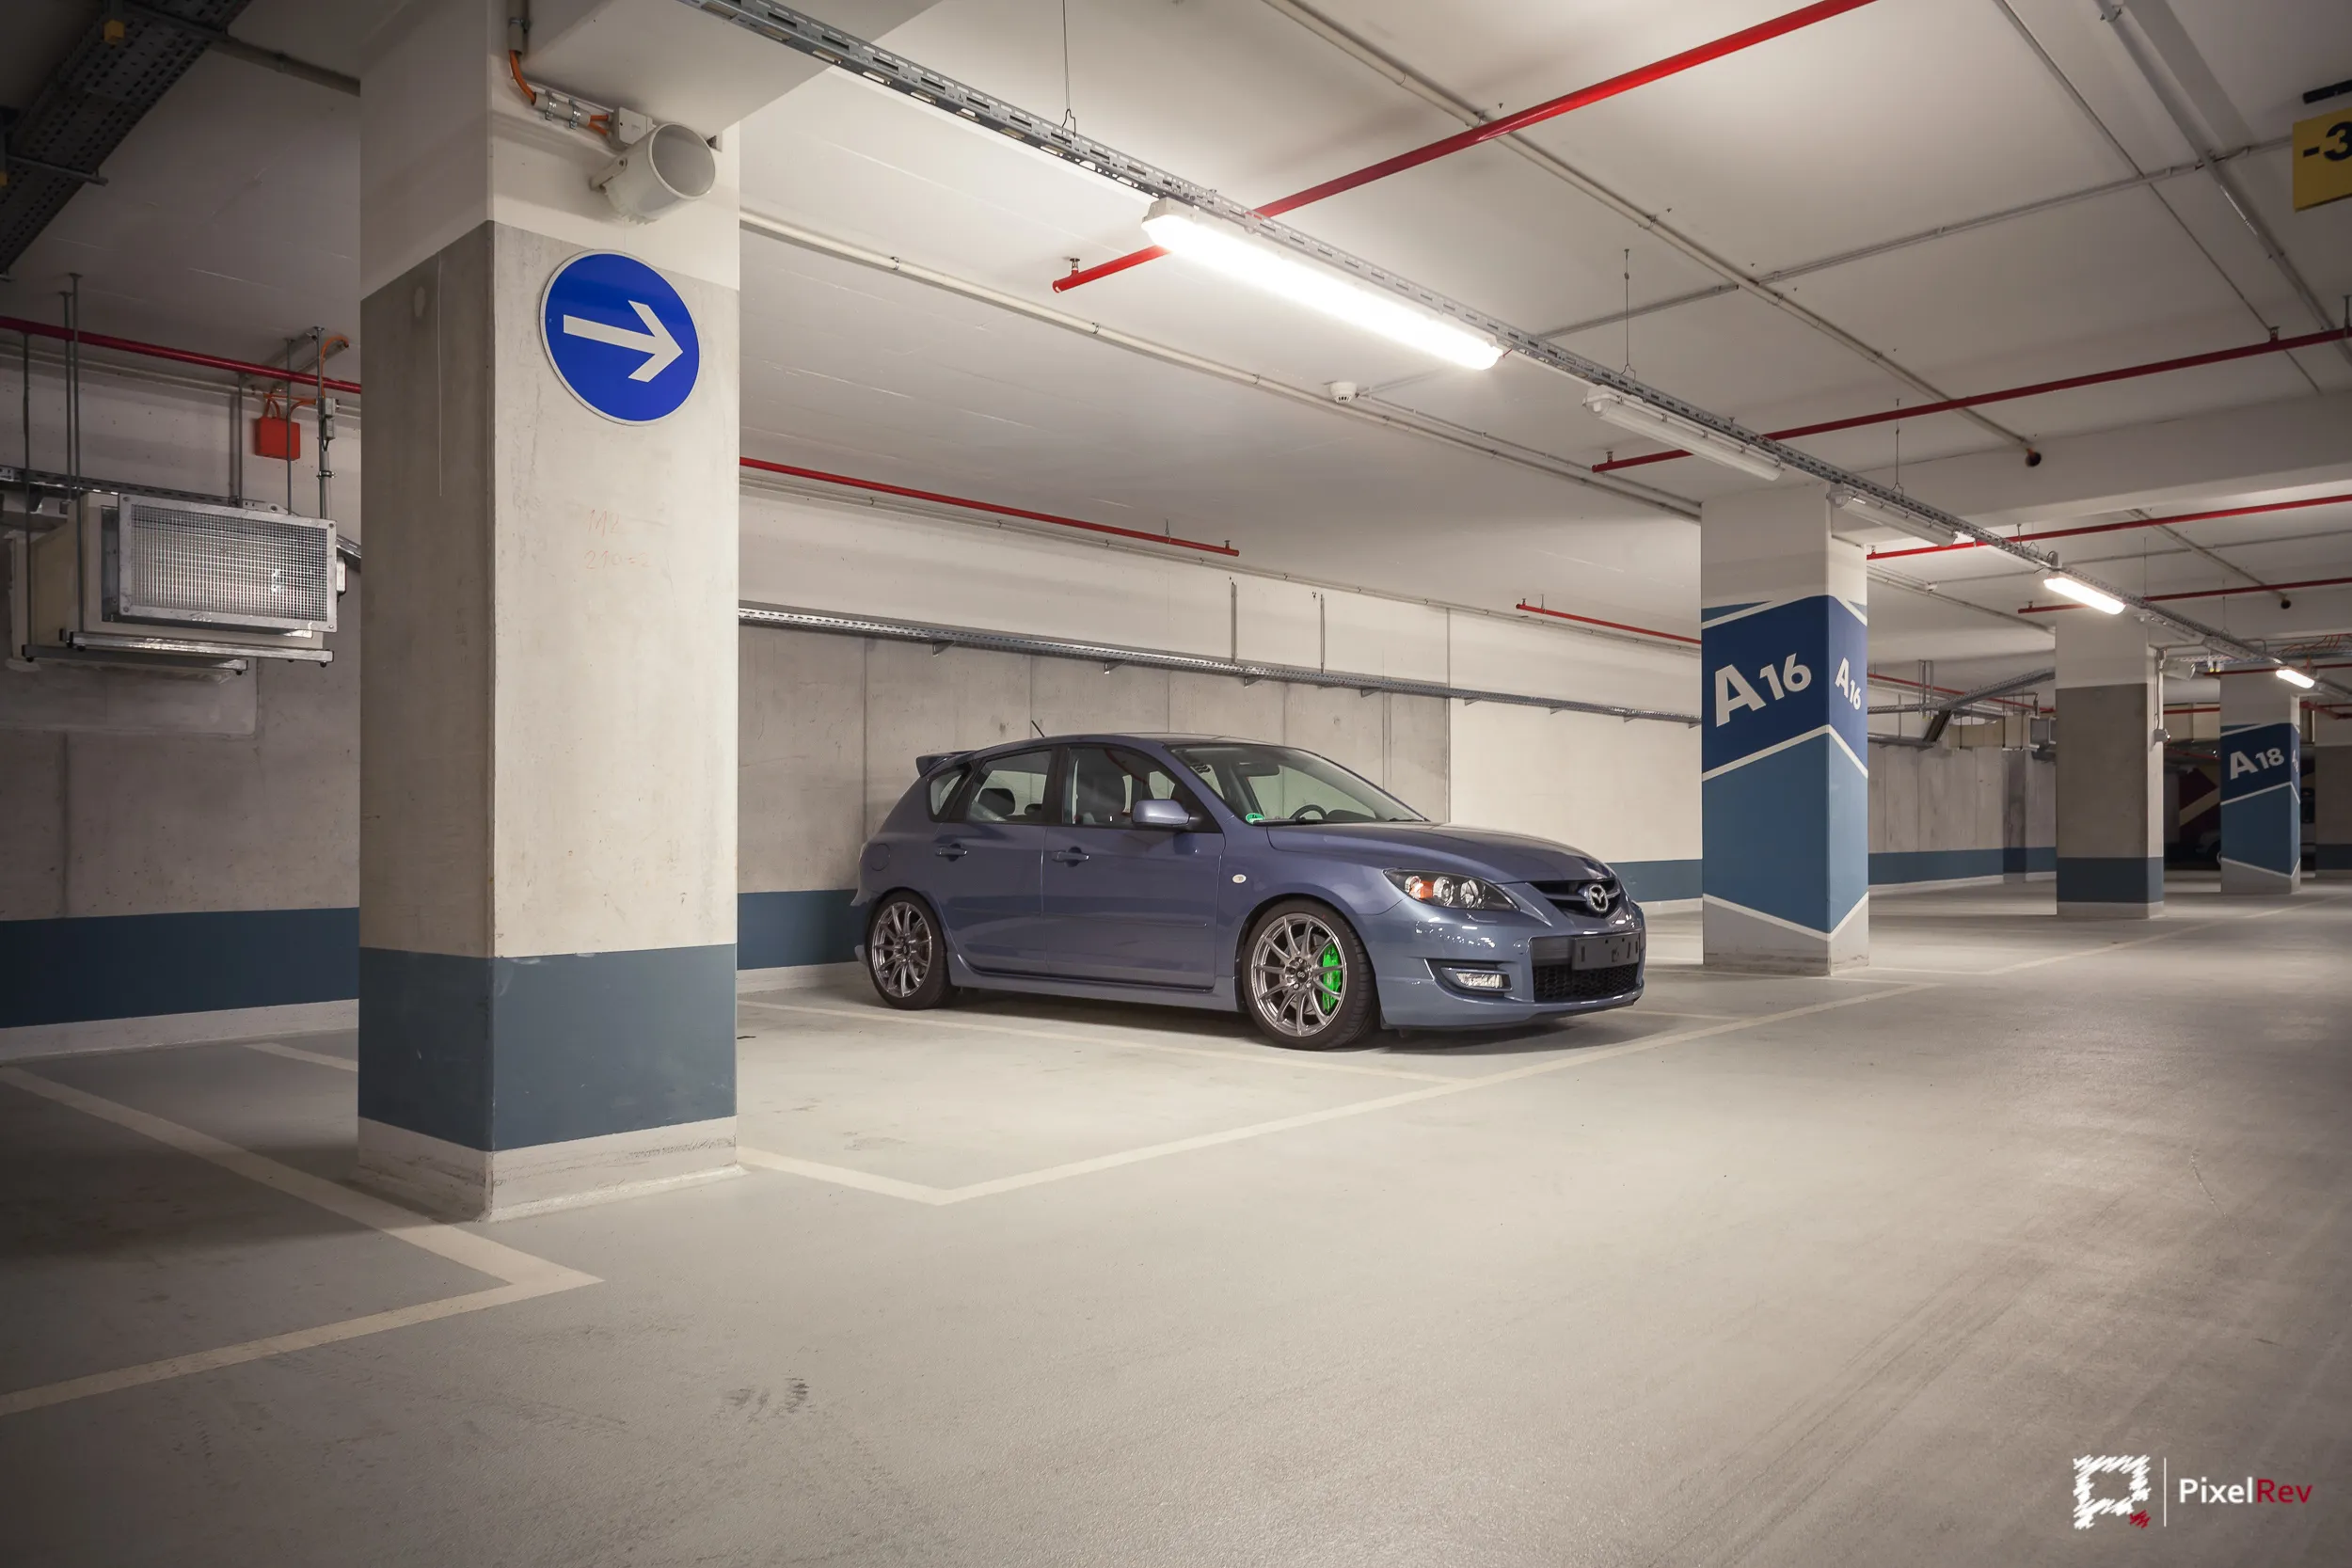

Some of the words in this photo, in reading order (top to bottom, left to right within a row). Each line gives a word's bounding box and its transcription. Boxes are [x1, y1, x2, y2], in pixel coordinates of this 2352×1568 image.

[1715, 653, 1812, 728] A16
[1835, 657, 1862, 710] A16
[2230, 748, 2284, 780] A18
